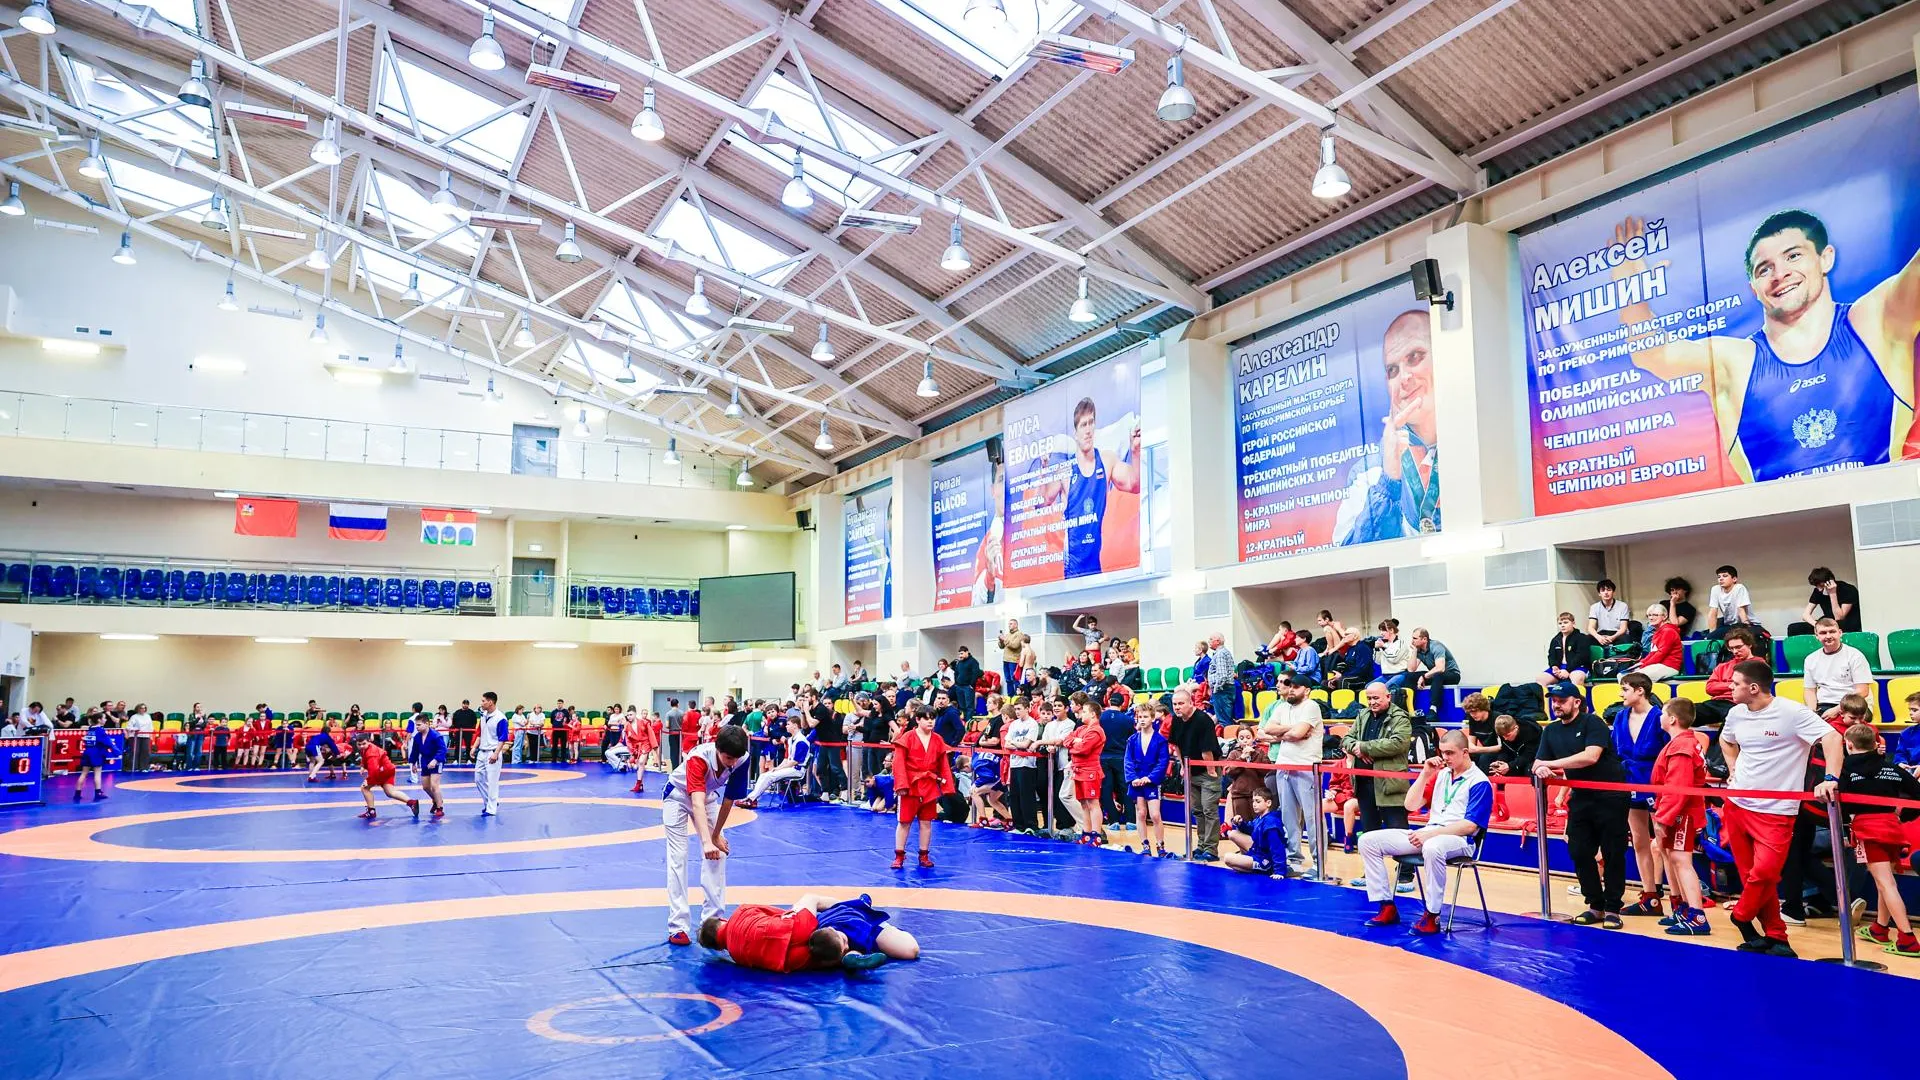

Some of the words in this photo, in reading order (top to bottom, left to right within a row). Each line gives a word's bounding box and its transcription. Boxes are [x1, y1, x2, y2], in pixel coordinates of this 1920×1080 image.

[1531, 218, 1668, 294] Алексей
[1534, 266, 1667, 334] МИШИН
[1537, 325, 1629, 362] ЗАСЛУЖЕННЫЙ
[1631, 312, 1683, 335] МАСТЕР
[1686, 295, 1742, 320] СПОРТА
[1239, 322, 1340, 377] Александр
[1538, 363, 1555, 377] ПО
[1559, 331, 1665, 373] ГРЕКО-РИМСКОЙ
[1668, 316, 1727, 343] БОРЬБЕ
[1239, 353, 1327, 405] КАРЕЛИН
[1539, 369, 1642, 404] ПОБЕДИТЕЛЬ
[1800, 373, 1827, 389] asics
[1241, 398, 1292, 423] ЗАСЛУЖЕННЫЙ
[1293, 389, 1323, 405] МАСТЕР
[1325, 378, 1354, 395] СПОРТА
[1540, 381, 1666, 423] ОЛИМПИЙСКИХ
[1669, 373, 1704, 396] ИГР
[1008, 414, 1040, 440] МУСА
[1242, 425, 1251, 435] ПО
[1252, 403, 1312, 430] ГРЕКО-РИМСКОЙ
[1313, 394, 1345, 411] БОРЬБЕ
[1543, 422, 1621, 450] ЧЕМПИОН
[1625, 411, 1675, 435] МИРА
[1242, 434, 1269, 453] ГЕРОЙ
[1271, 413, 1337, 444] РОССИЙСКОЙ
[1008, 435, 1054, 467] ЕВЛОЕВ
[1242, 442, 1296, 466] ФЕДЕРАЦИИ
[1310, 442, 1380, 467] ПОБЕДИТЕЛЬ
[1546, 445, 1636, 478] 6-КРАТНЫЙ
[933, 475, 961, 495] Роман
[1244, 475, 1315, 498] ОЛИМПИЙСКИХ
[1317, 468, 1336, 482] ИГР
[1548, 470, 1626, 495] ЧЕМПИОН
[1631, 455, 1706, 483] ЕВРОПЫ
[934, 491, 968, 515] ВЛАСОВ
[1244, 496, 1295, 519] 9-КРАТНЫЙ
[1296, 487, 1350, 508] ЧЕМПИОН
[1047, 518, 1077, 532] ЧЕМПИОН
[1078, 513, 1098, 526] МИРА
[1245, 519, 1271, 533] МИРА
[1245, 530, 1305, 554] 12-КРАТНЫЙ
[1011, 557, 1037, 570] ЧЕМПИОН
[1038, 551, 1064, 565] ЕВРОПЫ
[60, 743, 69, 754] 2
[18, 758, 30, 773] 0
